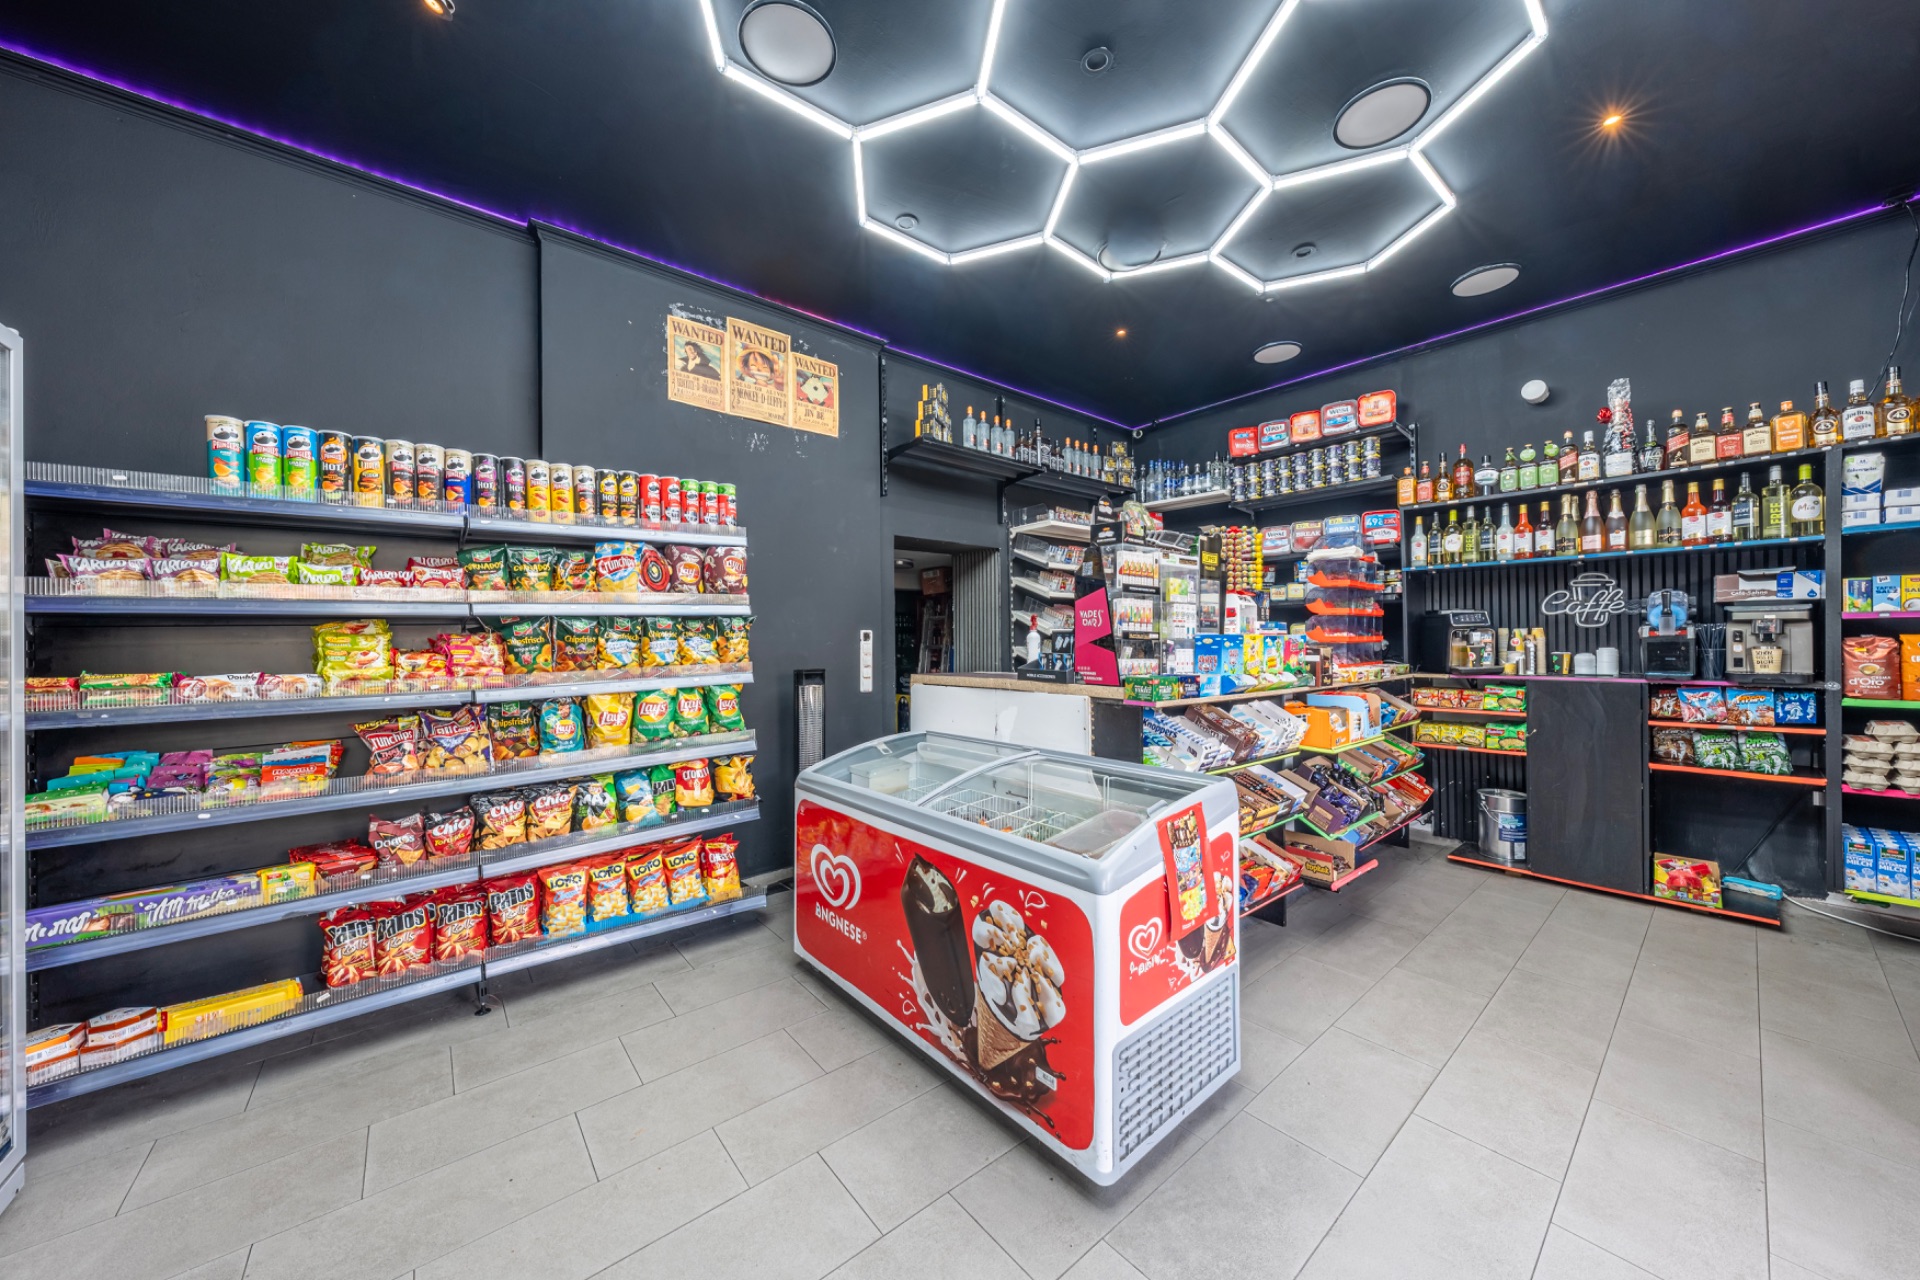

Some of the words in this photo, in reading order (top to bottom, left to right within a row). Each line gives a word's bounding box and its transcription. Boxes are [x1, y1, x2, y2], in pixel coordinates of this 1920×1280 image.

[672, 321, 724, 346] WANTED
[732, 325, 787, 354] WANTED
[794, 357, 836, 378] WANTED
[69, 556, 126, 572] KARUZO
[227, 559, 272, 574] KARUZO
[640, 702, 667, 716] Lay's
[1142, 718, 1179, 738] Knoppers
[535, 792, 570, 808] Chio
[490, 801, 524, 818] Chio
[433, 818, 472, 836] Chio
